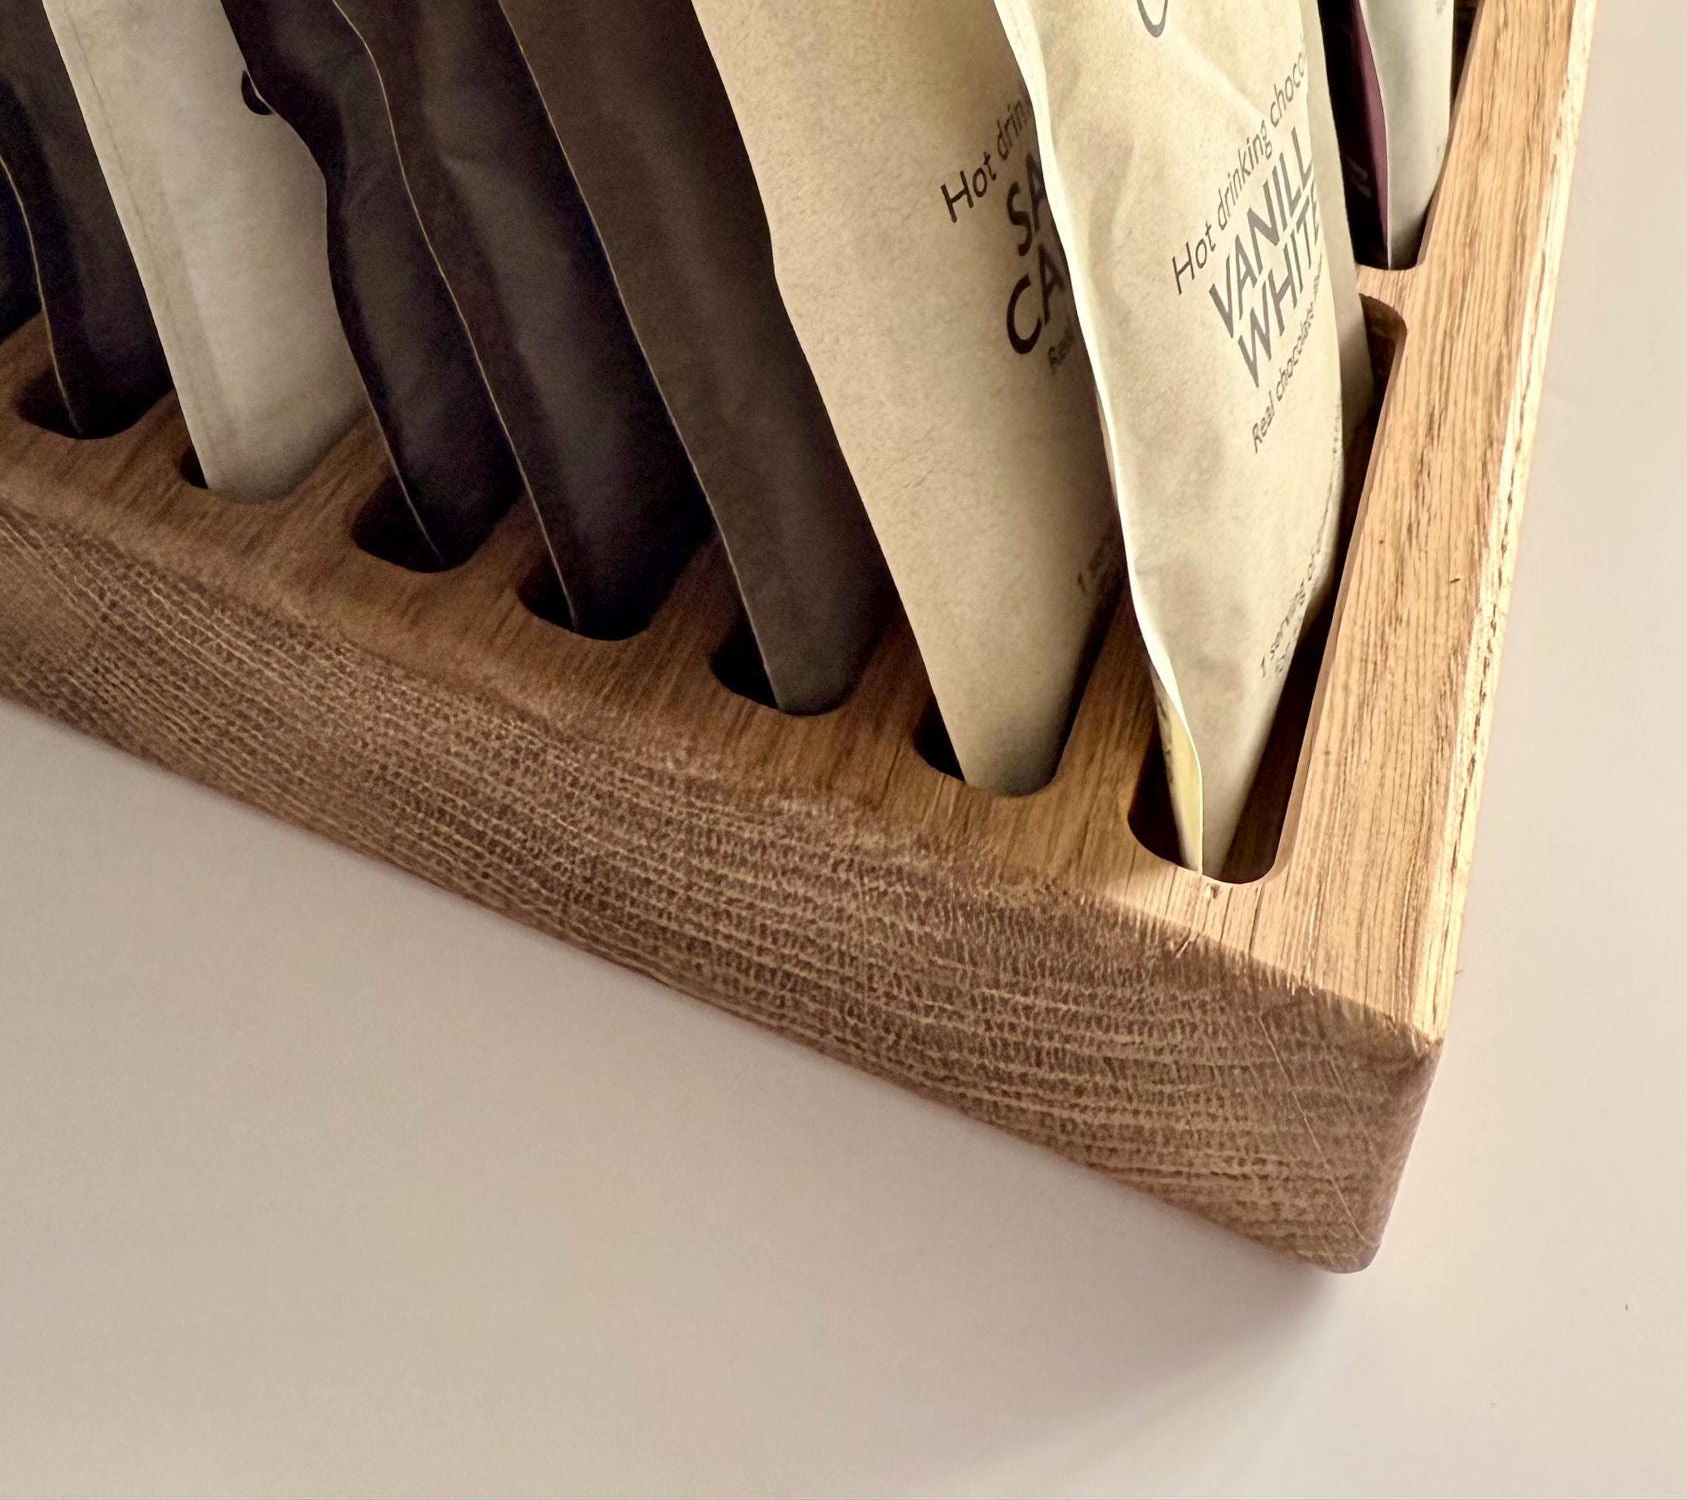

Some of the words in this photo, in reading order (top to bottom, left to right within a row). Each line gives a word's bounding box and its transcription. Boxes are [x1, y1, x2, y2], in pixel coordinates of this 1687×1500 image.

[940, 151, 998, 224] Hot
[1172, 219, 1216, 295] Hot
[1216, 118, 1273, 232] drinking
[1209, 125, 1313, 339] VANILL
[1006, 243, 1067, 355] CA
[1251, 390, 1276, 455] Real
